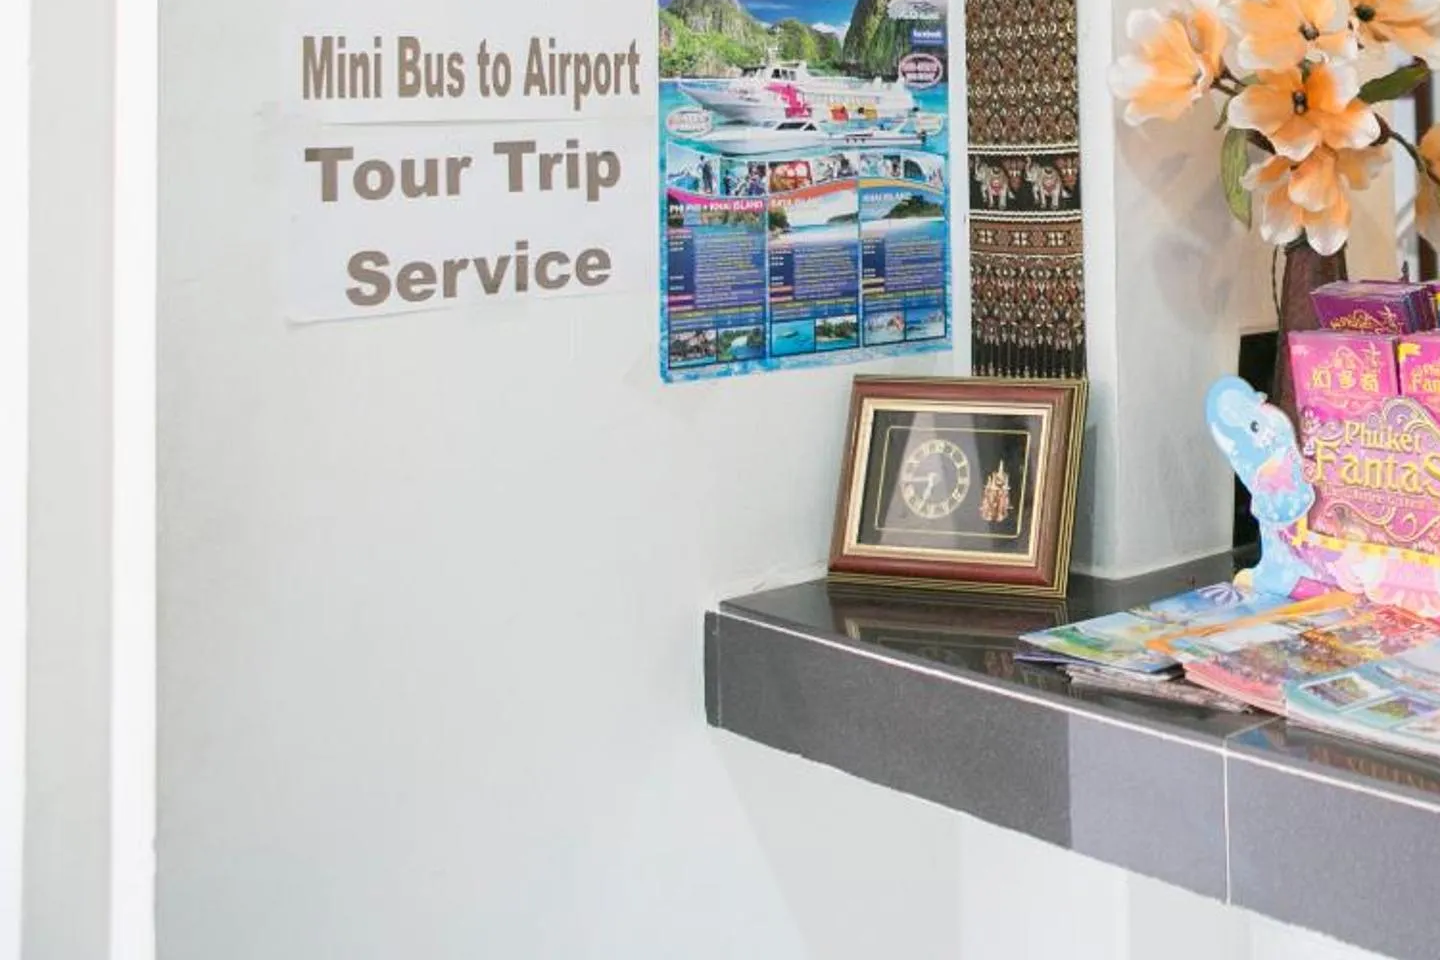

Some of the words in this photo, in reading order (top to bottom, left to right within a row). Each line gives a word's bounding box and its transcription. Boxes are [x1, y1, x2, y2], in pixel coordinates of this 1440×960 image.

[303, 35, 383, 100] Mini
[397, 36, 465, 99] Bus
[477, 39, 511, 98] to
[524, 37, 640, 111] Airport
[304, 145, 472, 203] Tour
[493, 138, 621, 201] Trip
[345, 240, 612, 307] Service
[1343, 420, 1423, 454] Phuket
